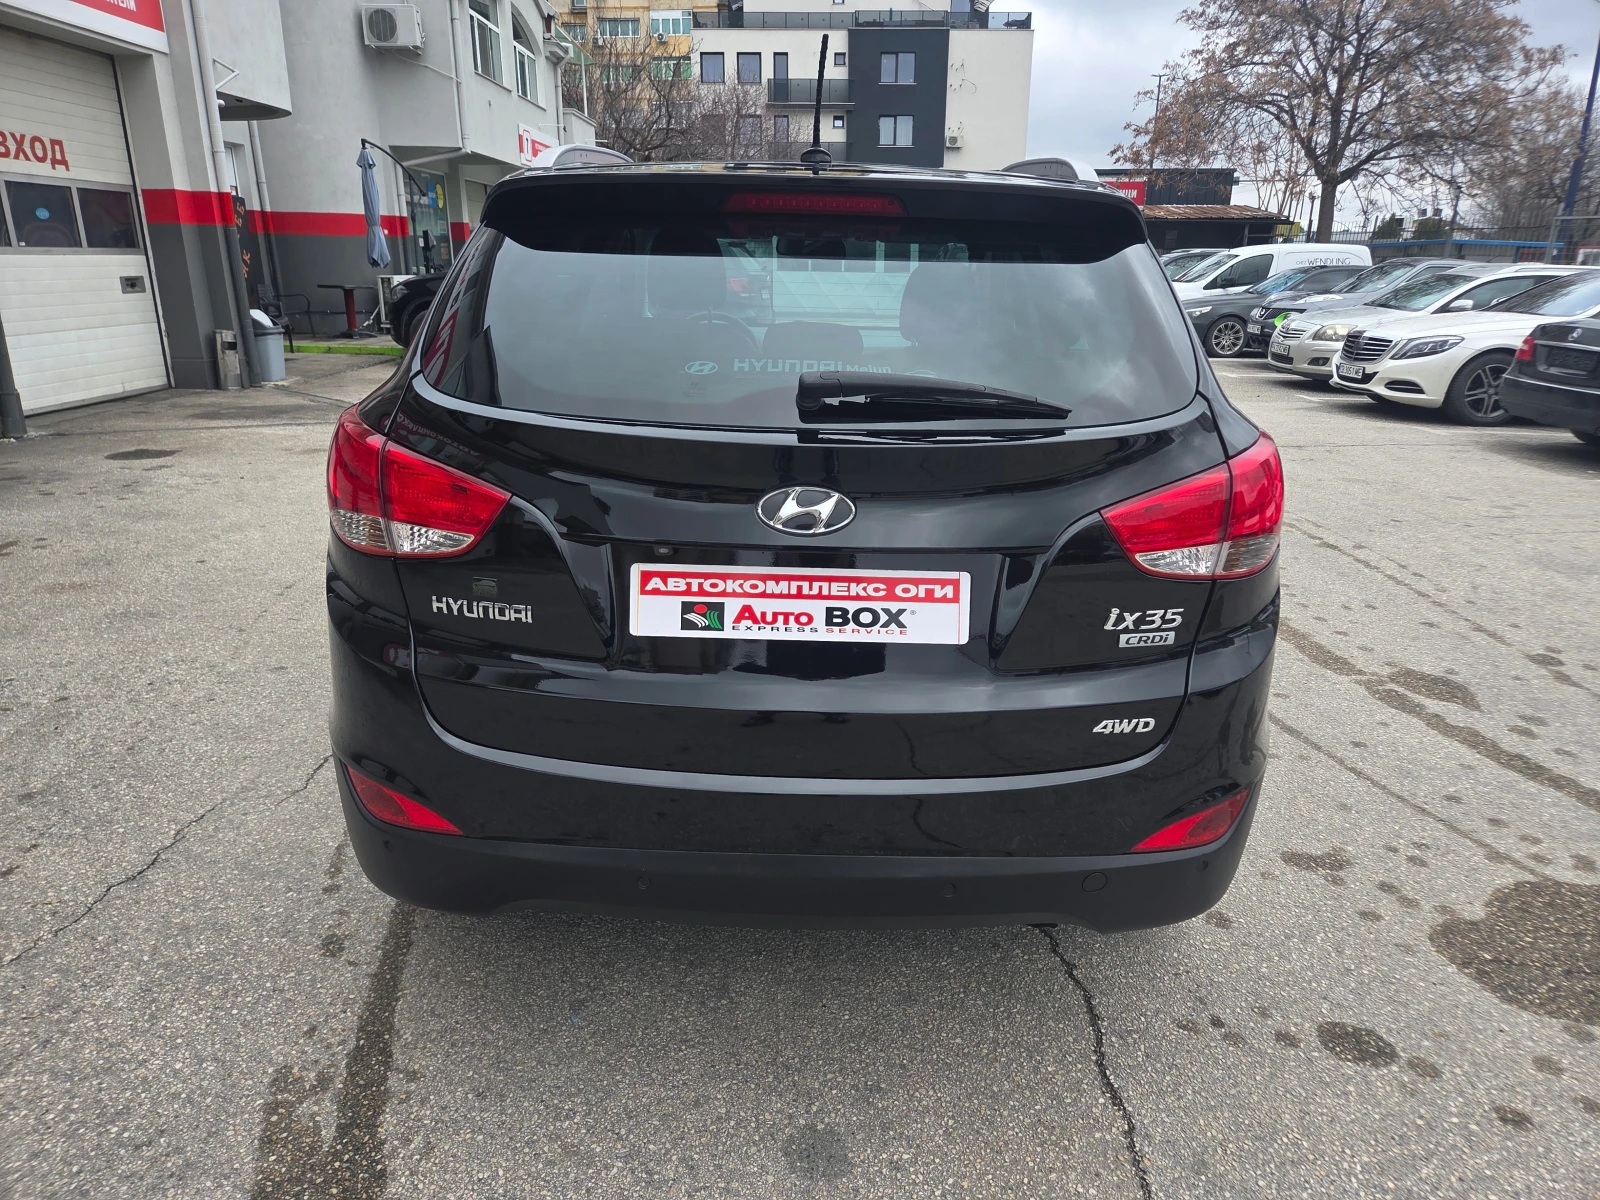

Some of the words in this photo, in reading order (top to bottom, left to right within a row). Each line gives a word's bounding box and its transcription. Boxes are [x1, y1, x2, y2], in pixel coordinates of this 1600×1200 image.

[733, 358, 843, 373] HYUNDAI
[644, 577, 887, 597] АВТОКОМПЛЕКС
[894, 583, 954, 599] ОГИ
[431, 595, 533, 624] HYUNDAI
[824, 606, 908, 629] BOX
[731, 625, 819, 633] EXPRESS
[825, 628, 908, 636] SERVICE
[1125, 633, 1170, 646] CRDi
[1092, 717, 1156, 735] 4WD
